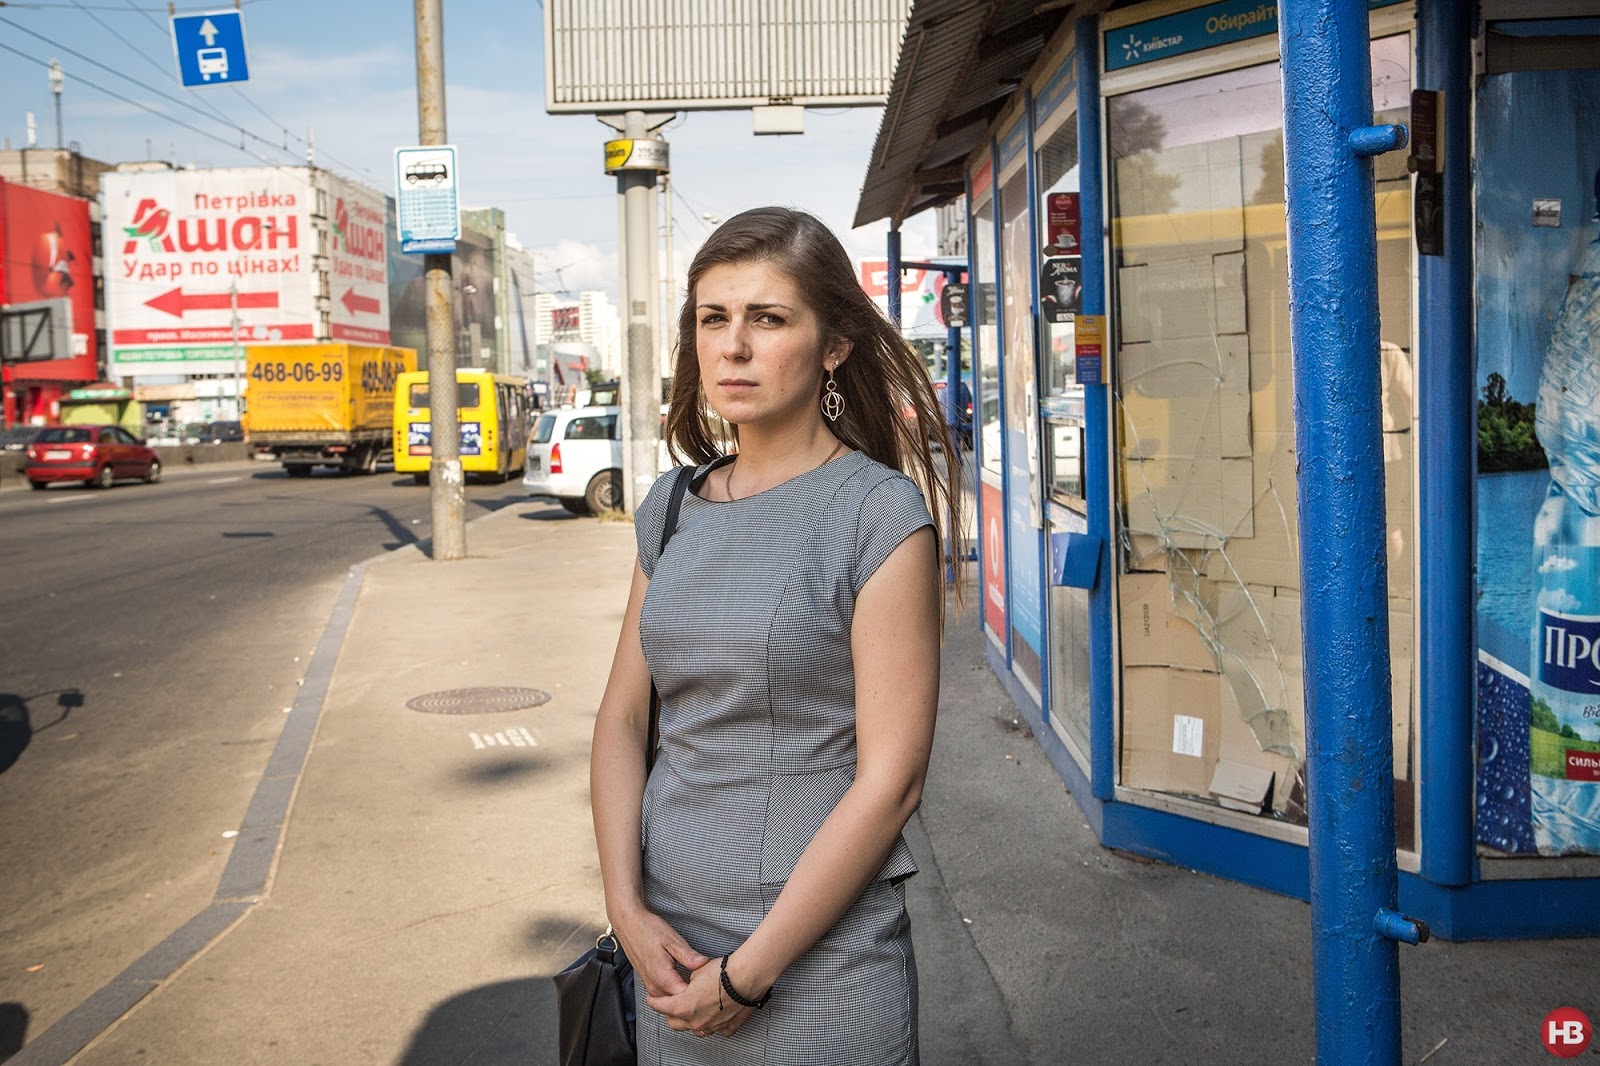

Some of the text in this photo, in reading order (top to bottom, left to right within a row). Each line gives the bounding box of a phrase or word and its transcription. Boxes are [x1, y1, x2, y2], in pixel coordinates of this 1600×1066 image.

[194, 192, 297, 212] Петрівка
[122, 198, 298, 254] Ашан
[123, 255, 301, 281] Удар по цінах!
[251, 362, 343, 382] 468-06-99
